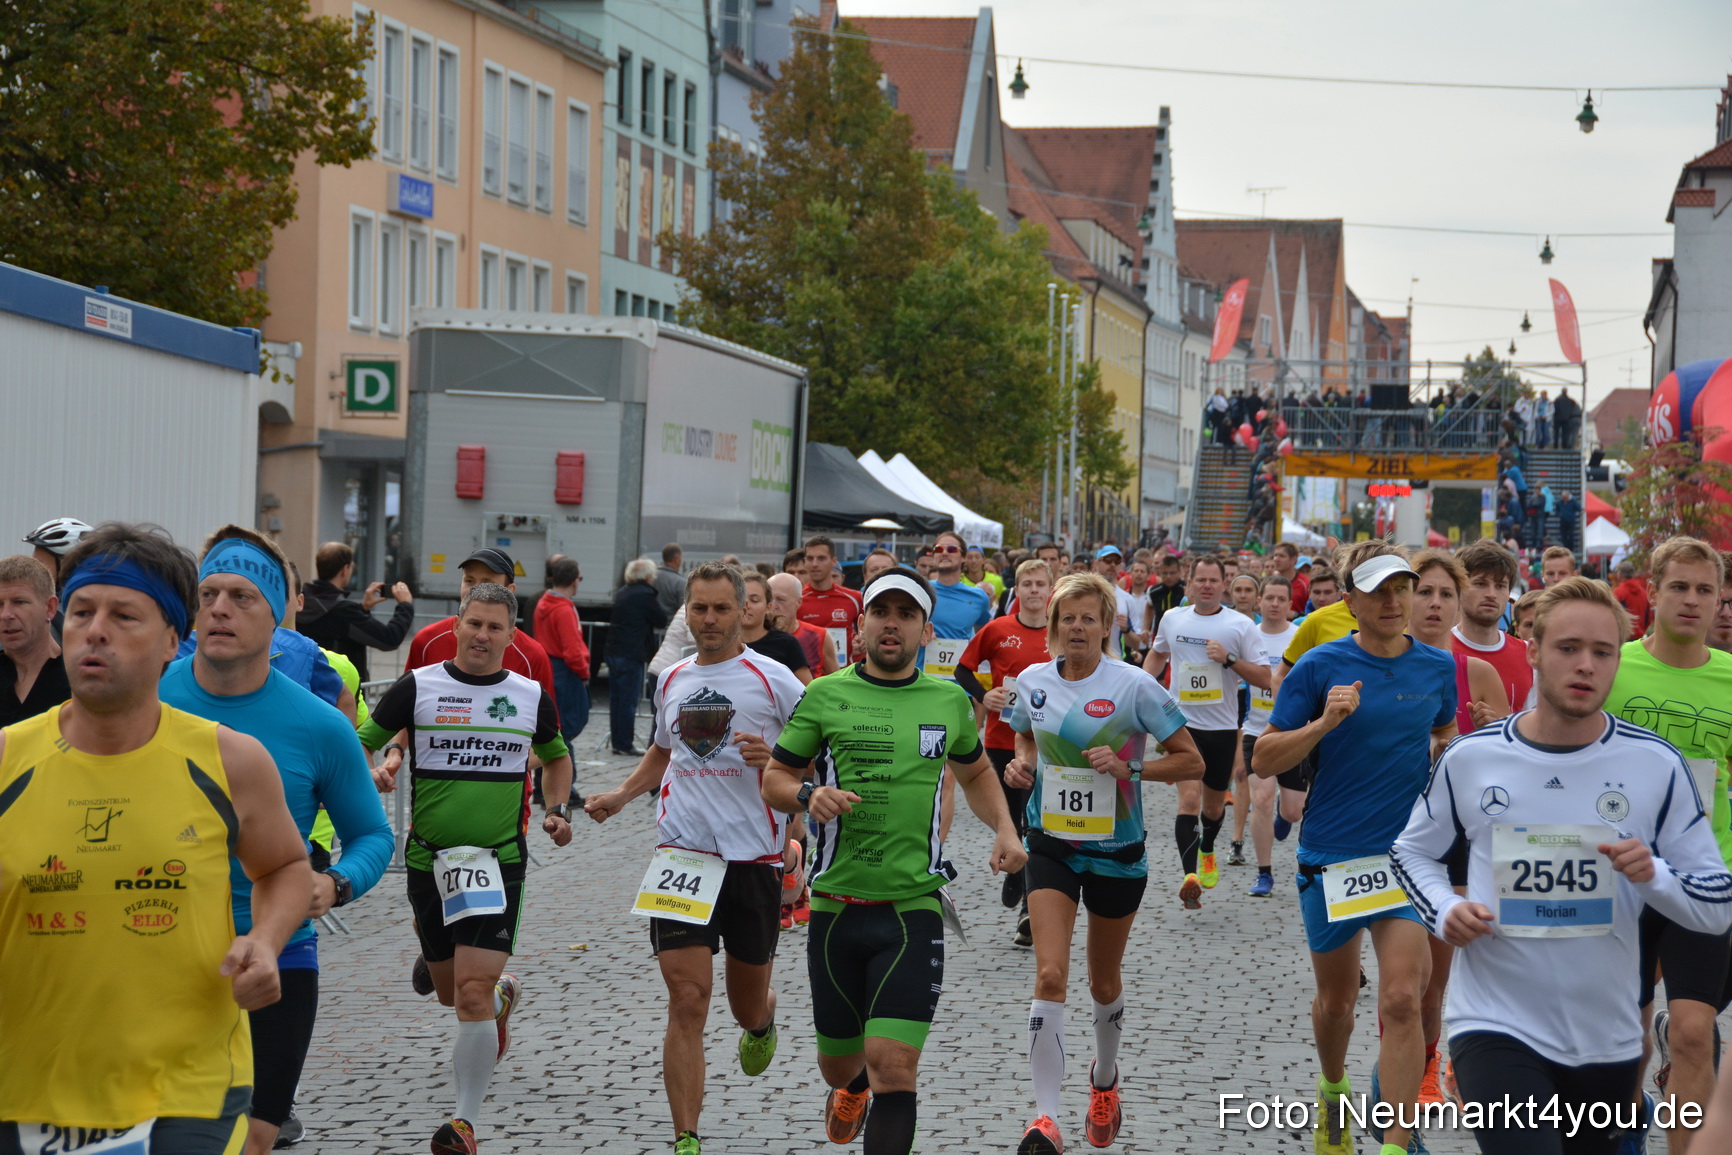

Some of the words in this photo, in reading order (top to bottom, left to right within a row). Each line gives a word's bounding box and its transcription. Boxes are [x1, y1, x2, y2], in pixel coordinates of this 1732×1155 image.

[354, 368, 390, 405] D
[662, 422, 683, 454] OFFICE
[684, 425, 713, 458] INDUSTRY
[714, 431, 737, 462] LOUNGE
[750, 422, 791, 489] BOCK
[1366, 458, 1414, 476] ZIEL
[939, 651, 954, 663] 97
[1191, 676, 1207, 689] 60
[1088, 704, 1112, 713] Hervis
[435, 716, 471, 724] OBI
[852, 725, 889, 733] solectrix
[430, 737, 522, 752] Laufteam
[447, 753, 502, 767] Fürth
[68, 798, 130, 807] FONDSZENTRUM
[1058, 789, 1093, 812] 181
[1067, 819, 1085, 828] Heidi
[1540, 835, 1582, 844] BOCK
[76, 844, 122, 853] NEUMARKT
[855, 847, 884, 856] PHYSIO
[167, 864, 184, 872] Esso
[22, 870, 83, 887] NEUMARKTER
[443, 867, 490, 893] 2776
[657, 869, 702, 896] 244
[1511, 859, 1598, 893] 2545
[29, 884, 78, 893] MINERALBRUNNEN
[1344, 871, 1388, 897] 299
[124, 899, 179, 916] PIZZERIA
[655, 897, 692, 911] Wolfgang
[1535, 905, 1577, 918] Florian
[27, 913, 43, 929] M
[50, 912, 66, 928] &
[74, 911, 87, 928] S
[132, 914, 173, 927] ELIO
